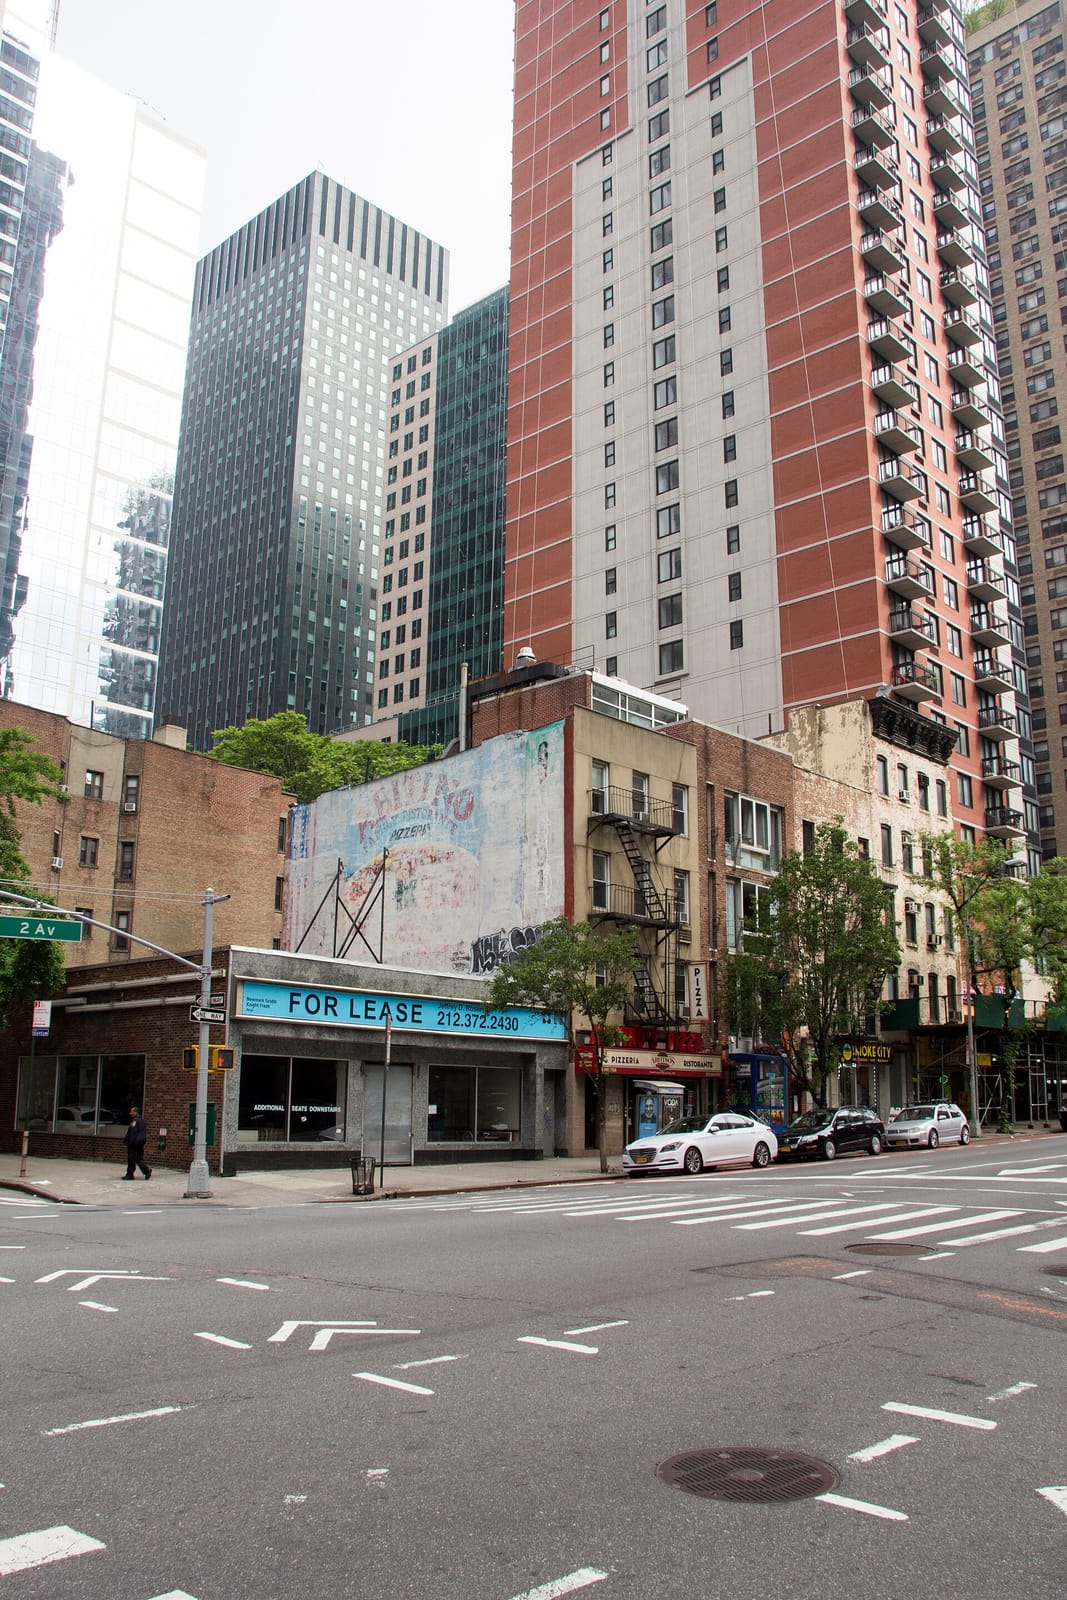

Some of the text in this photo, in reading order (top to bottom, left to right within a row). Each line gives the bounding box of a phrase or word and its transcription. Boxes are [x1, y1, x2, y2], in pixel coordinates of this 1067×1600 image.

[19, 922, 55, 936] 2 Av
[694, 967, 703, 1017] PIZZA
[195, 1010, 206, 1018] ONE
[289, 992, 422, 1024] FOR LEASE
[437, 1011, 519, 1031] 212.372.2430
[611, 1056, 640, 1065] PIZZERIA
[683, 1060, 713, 1069] RISTORANTE
[253, 1104, 285, 1112] ADDITIONAL
[309, 1105, 342, 1113] DOWNSTAIRS
